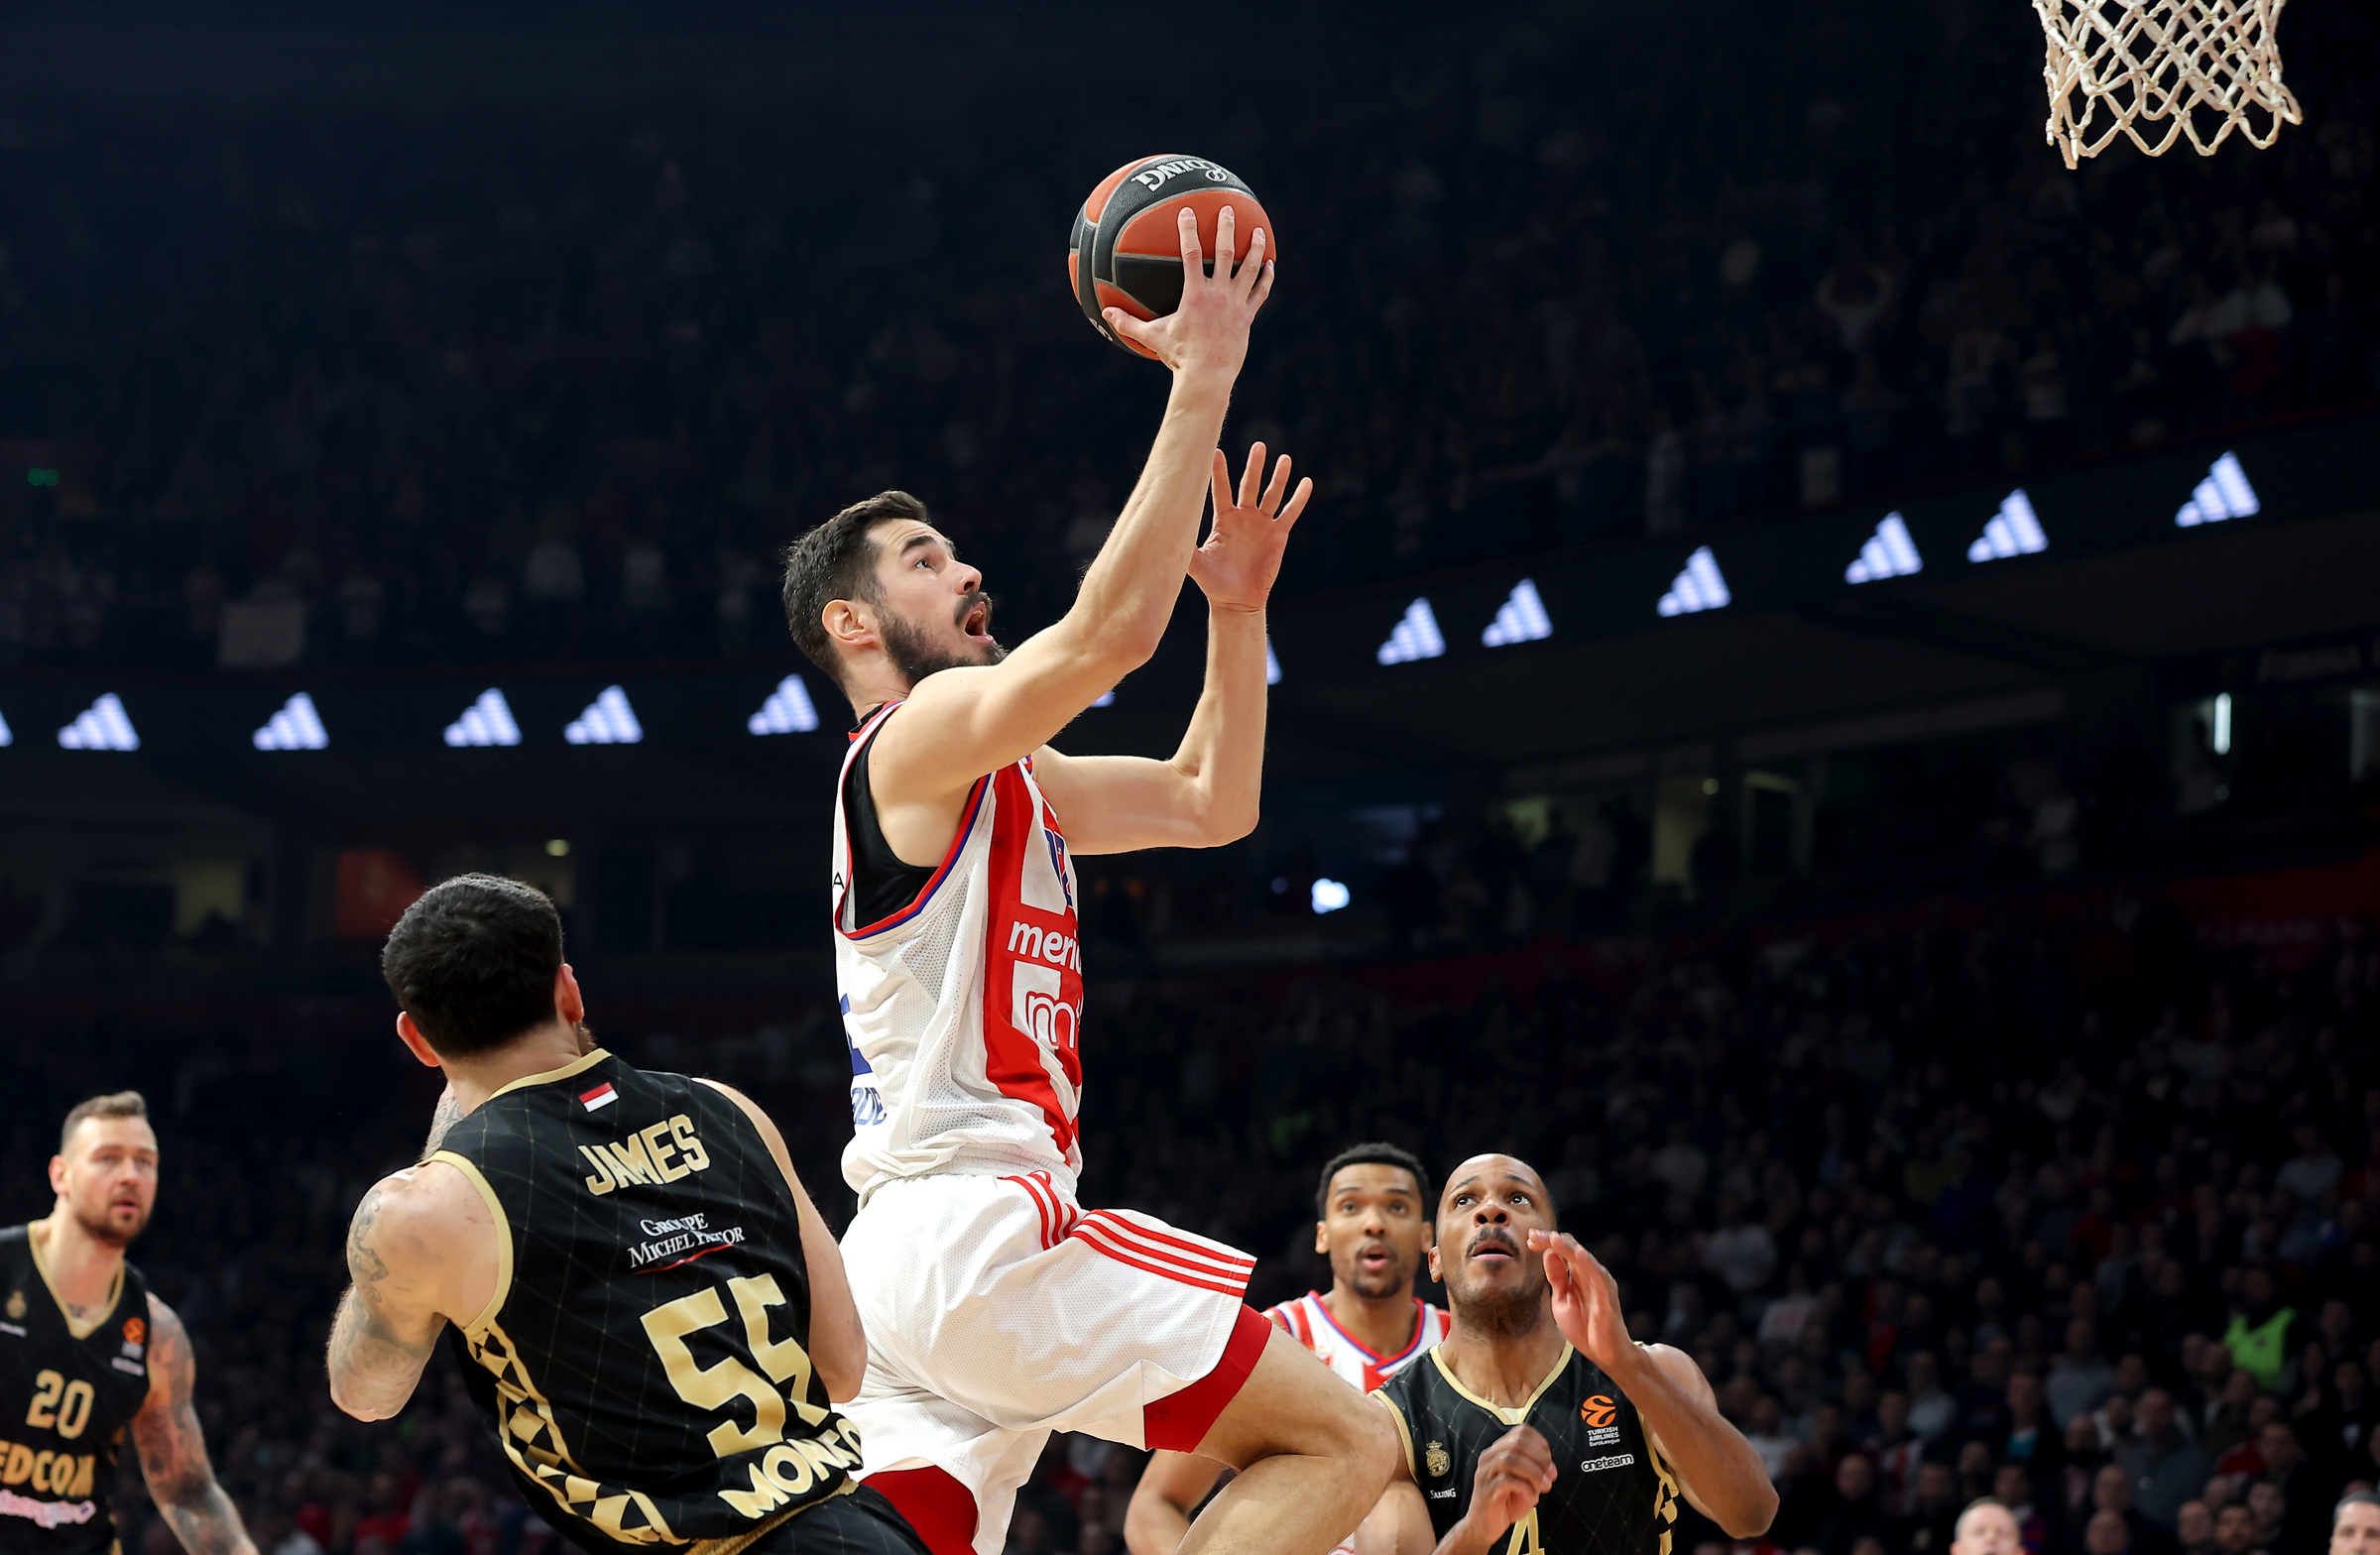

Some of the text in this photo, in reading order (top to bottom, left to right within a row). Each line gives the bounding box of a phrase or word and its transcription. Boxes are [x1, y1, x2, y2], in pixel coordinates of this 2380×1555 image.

[577, 1114, 711, 1195] JAMES
[640, 1212, 709, 1237] GROUPE
[627, 1234, 695, 1268] MICHEL
[640, 1272, 829, 1458] 55
[25, 1369, 95, 1439] 20
[1587, 1426, 1618, 1436] TURKISH
[1589, 1432, 1619, 1442] AIRLINES
[1582, 1454, 1634, 1472] oneteam
